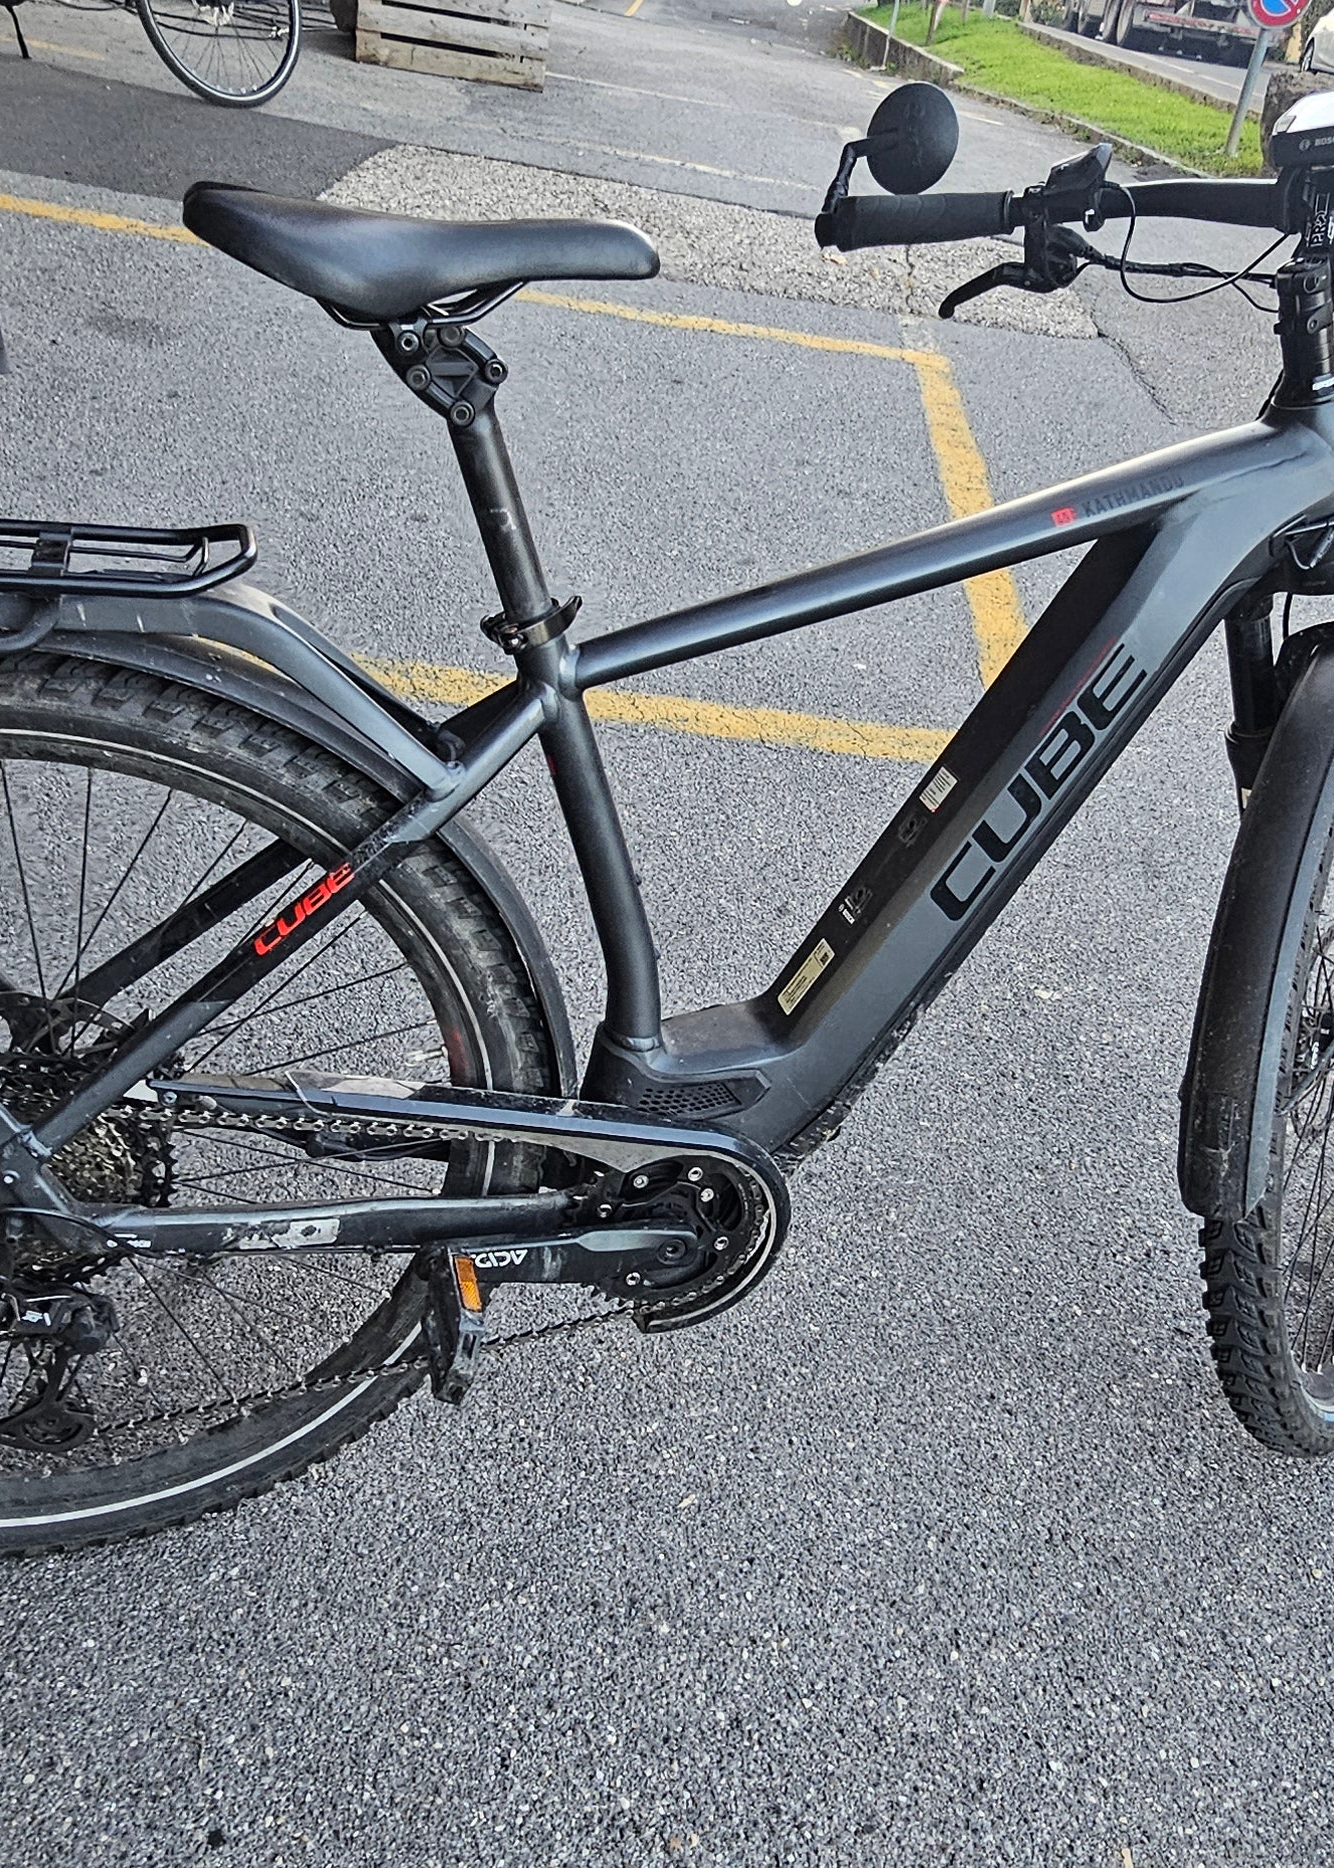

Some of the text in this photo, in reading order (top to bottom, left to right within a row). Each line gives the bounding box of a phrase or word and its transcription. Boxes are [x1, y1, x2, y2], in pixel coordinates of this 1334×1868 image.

[1081, 475, 1185, 518] KATHMANDU
[929, 643, 1148, 921] CUBE
[254, 861, 356, 956] CUBE
